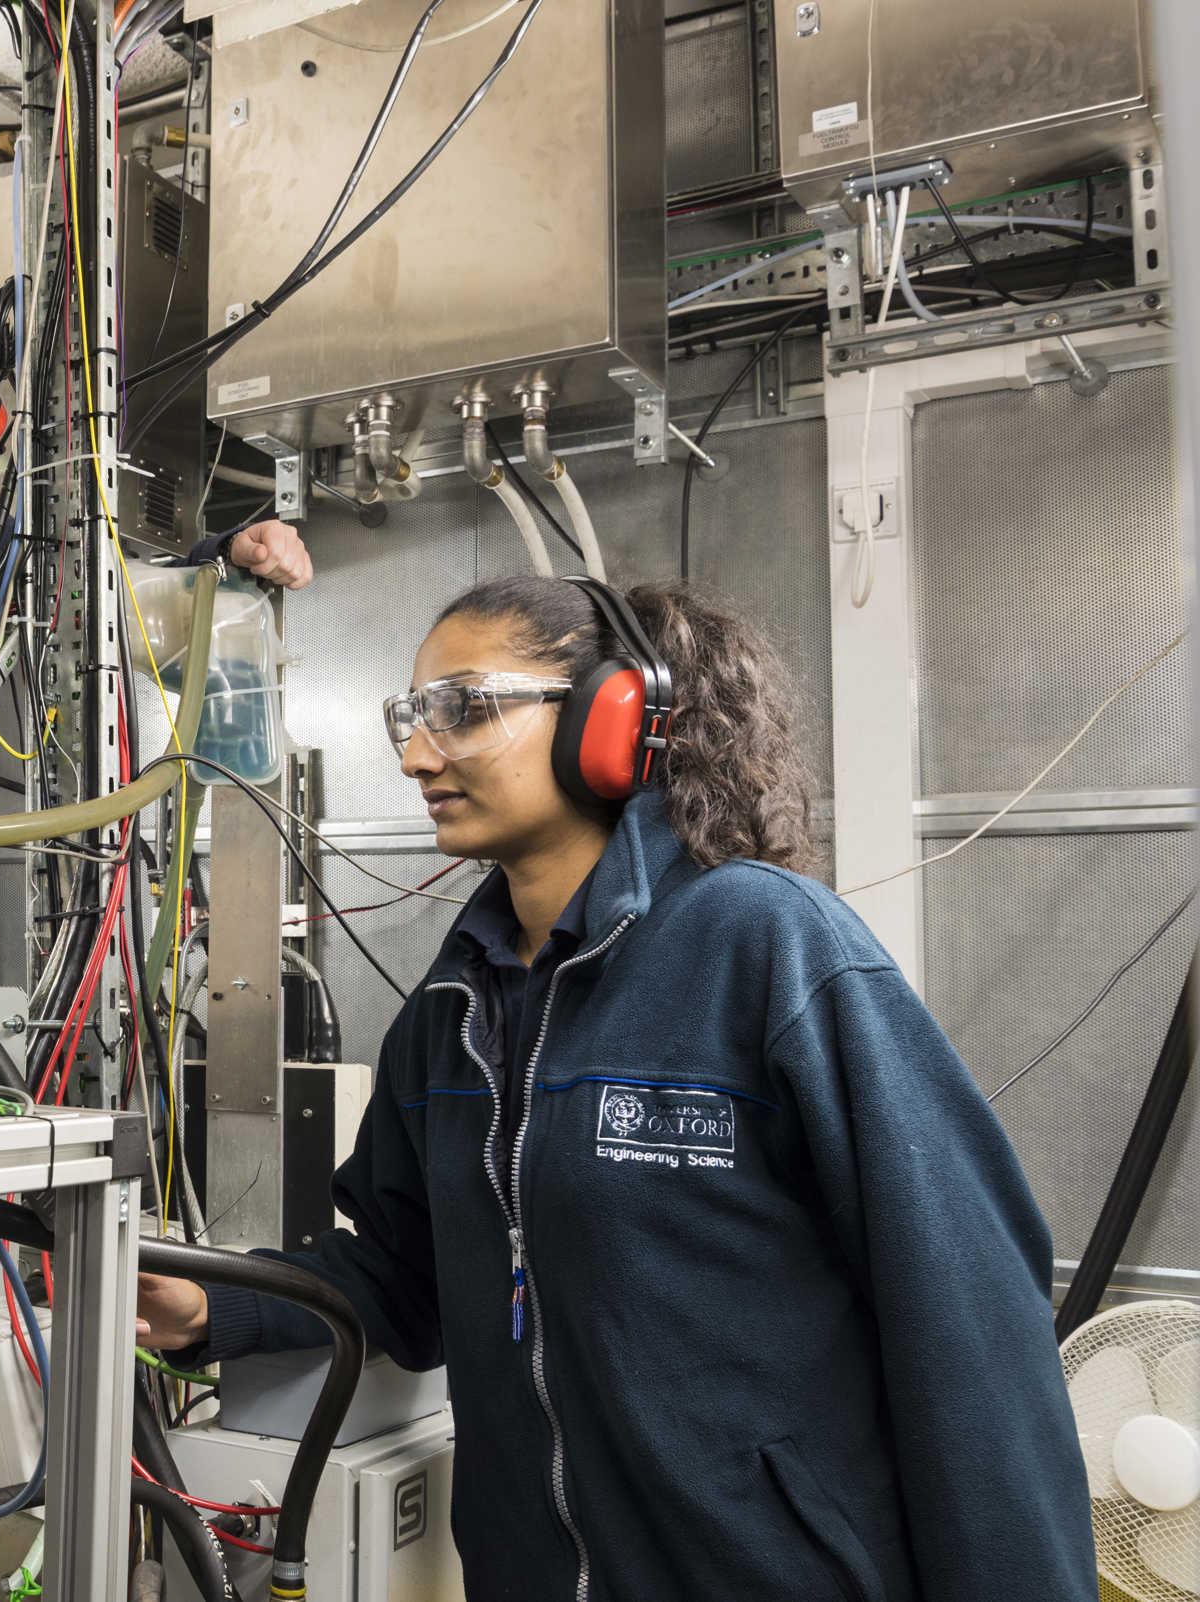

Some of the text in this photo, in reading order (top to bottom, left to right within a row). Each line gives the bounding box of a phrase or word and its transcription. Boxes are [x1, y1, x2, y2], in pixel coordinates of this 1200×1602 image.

[648, 1115, 731, 1137] OXFORD
[596, 1144, 734, 1169] Engineering Science
